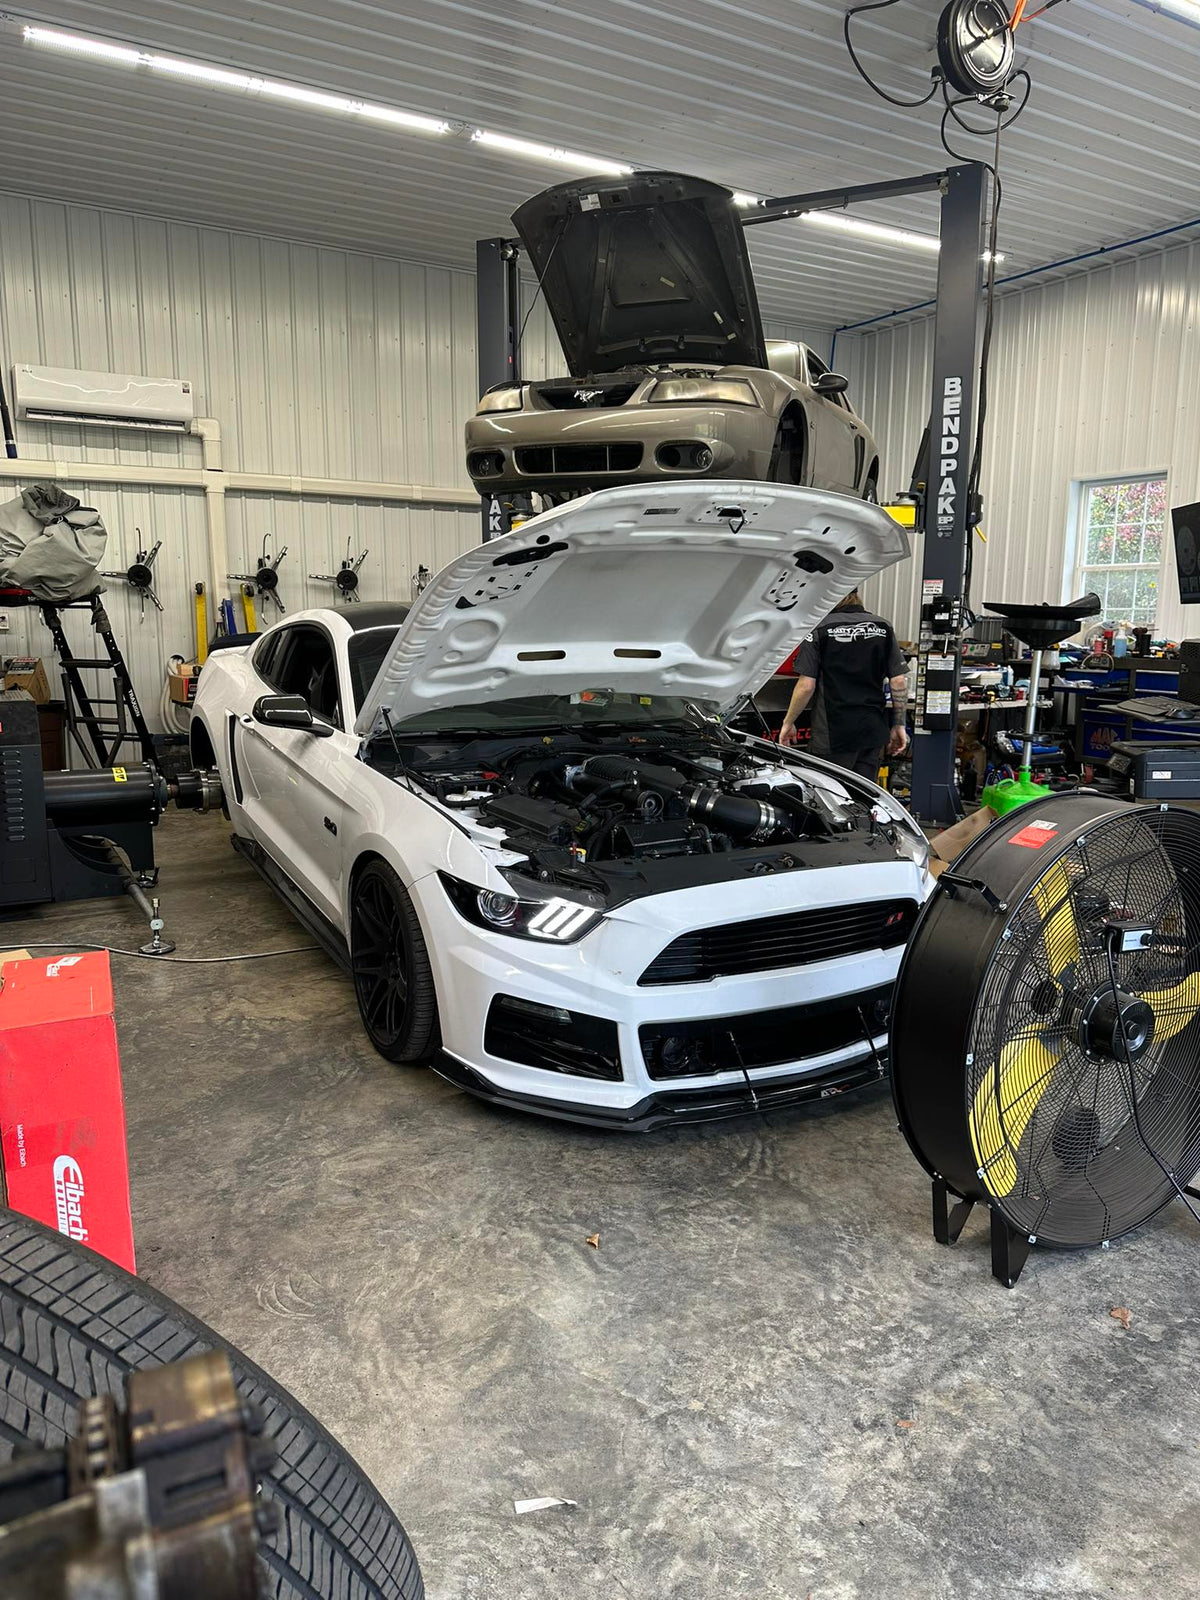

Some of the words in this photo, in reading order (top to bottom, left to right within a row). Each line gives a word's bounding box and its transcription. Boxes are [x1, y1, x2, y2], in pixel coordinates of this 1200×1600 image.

[936, 376, 963, 515] BENDPAK
[489, 494, 502, 531] AK
[867, 626, 887, 635] AUTO
[17, 1140, 25, 1148] by
[19, 1148, 27, 1168] Eibach
[53, 1154, 89, 1241] Eibach
